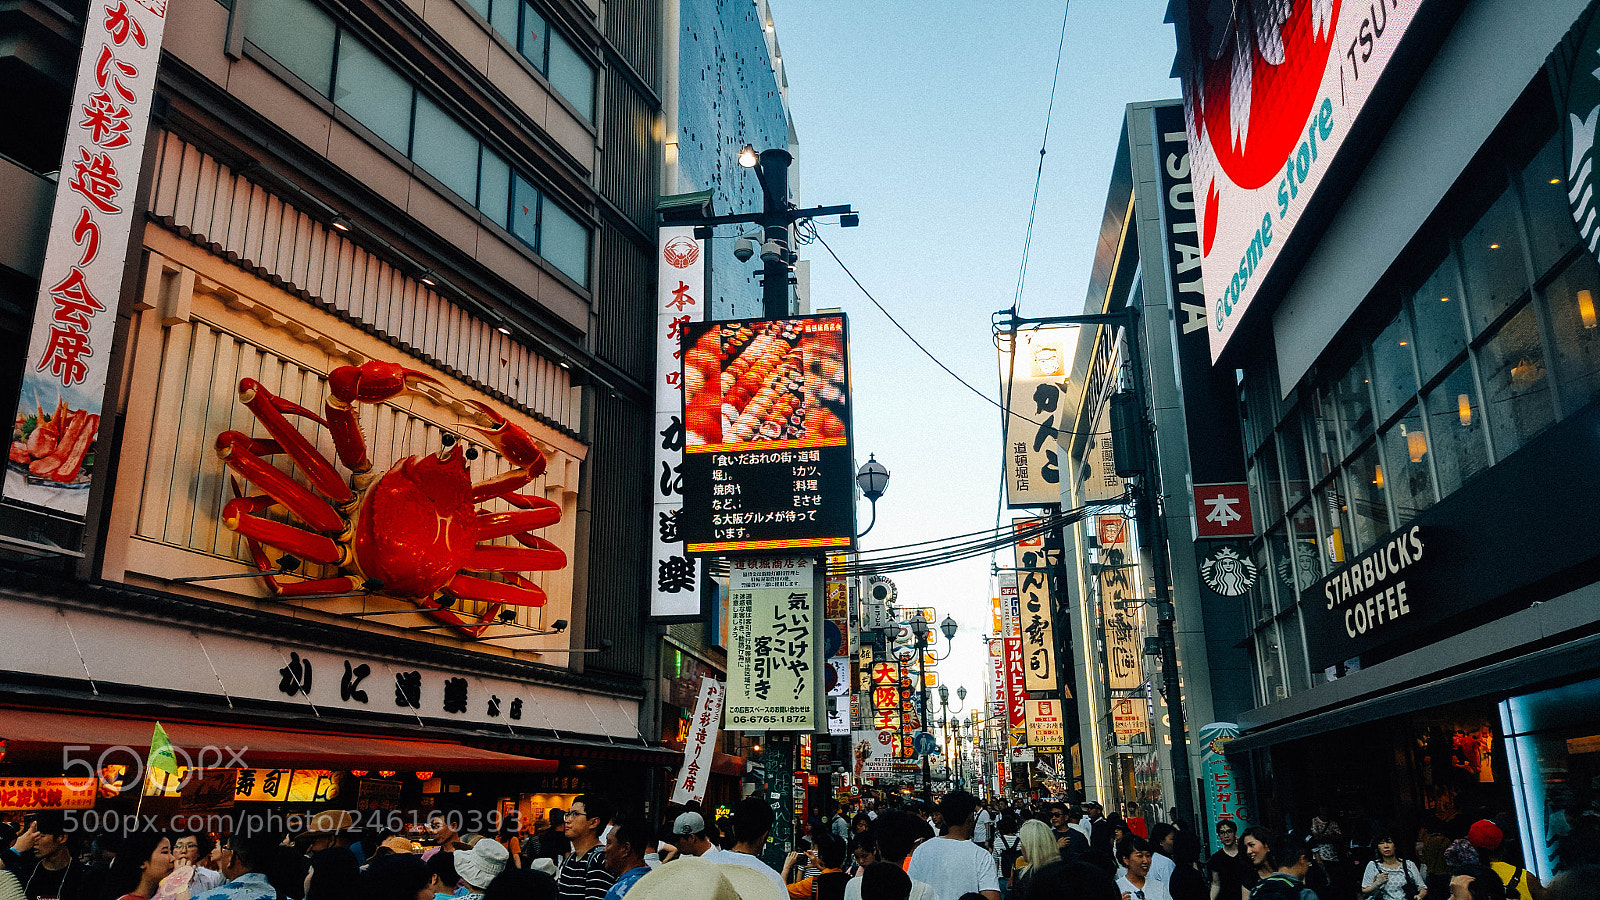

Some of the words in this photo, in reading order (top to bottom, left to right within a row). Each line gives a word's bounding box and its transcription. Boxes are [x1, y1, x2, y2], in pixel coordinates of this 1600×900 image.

[1277, 97, 1334, 220] store
[1347, 0, 1397, 81] TSU
[37, 1, 148, 387] かに彩造り会席
[712, 450, 821, 467] 「食いだおれの街・道頓
[1013, 441, 1029, 492] 道頓堀店
[712, 469, 733, 481] 堀」。
[712, 499, 742, 511] など、
[712, 510, 818, 526] る大阪グルメが待って
[1204, 494, 1242, 527] 本
[714, 527, 751, 540] います。
[734, 557, 808, 570] 道頓堀商店会
[1325, 525, 1424, 610] STARBUCKS
[1345, 580, 1411, 639] COFFEE
[772, 605, 788, 670] しつこい
[754, 635, 773, 700] 客引き
[487, 694, 523, 720] 本店
[729, 706, 811, 714] この広告スペースのお問い合わせは
[733, 715, 808, 724] 06-6765-1872
[682, 686, 718, 793] かに彩造り会席
[880, 734, 891, 742] 2F
